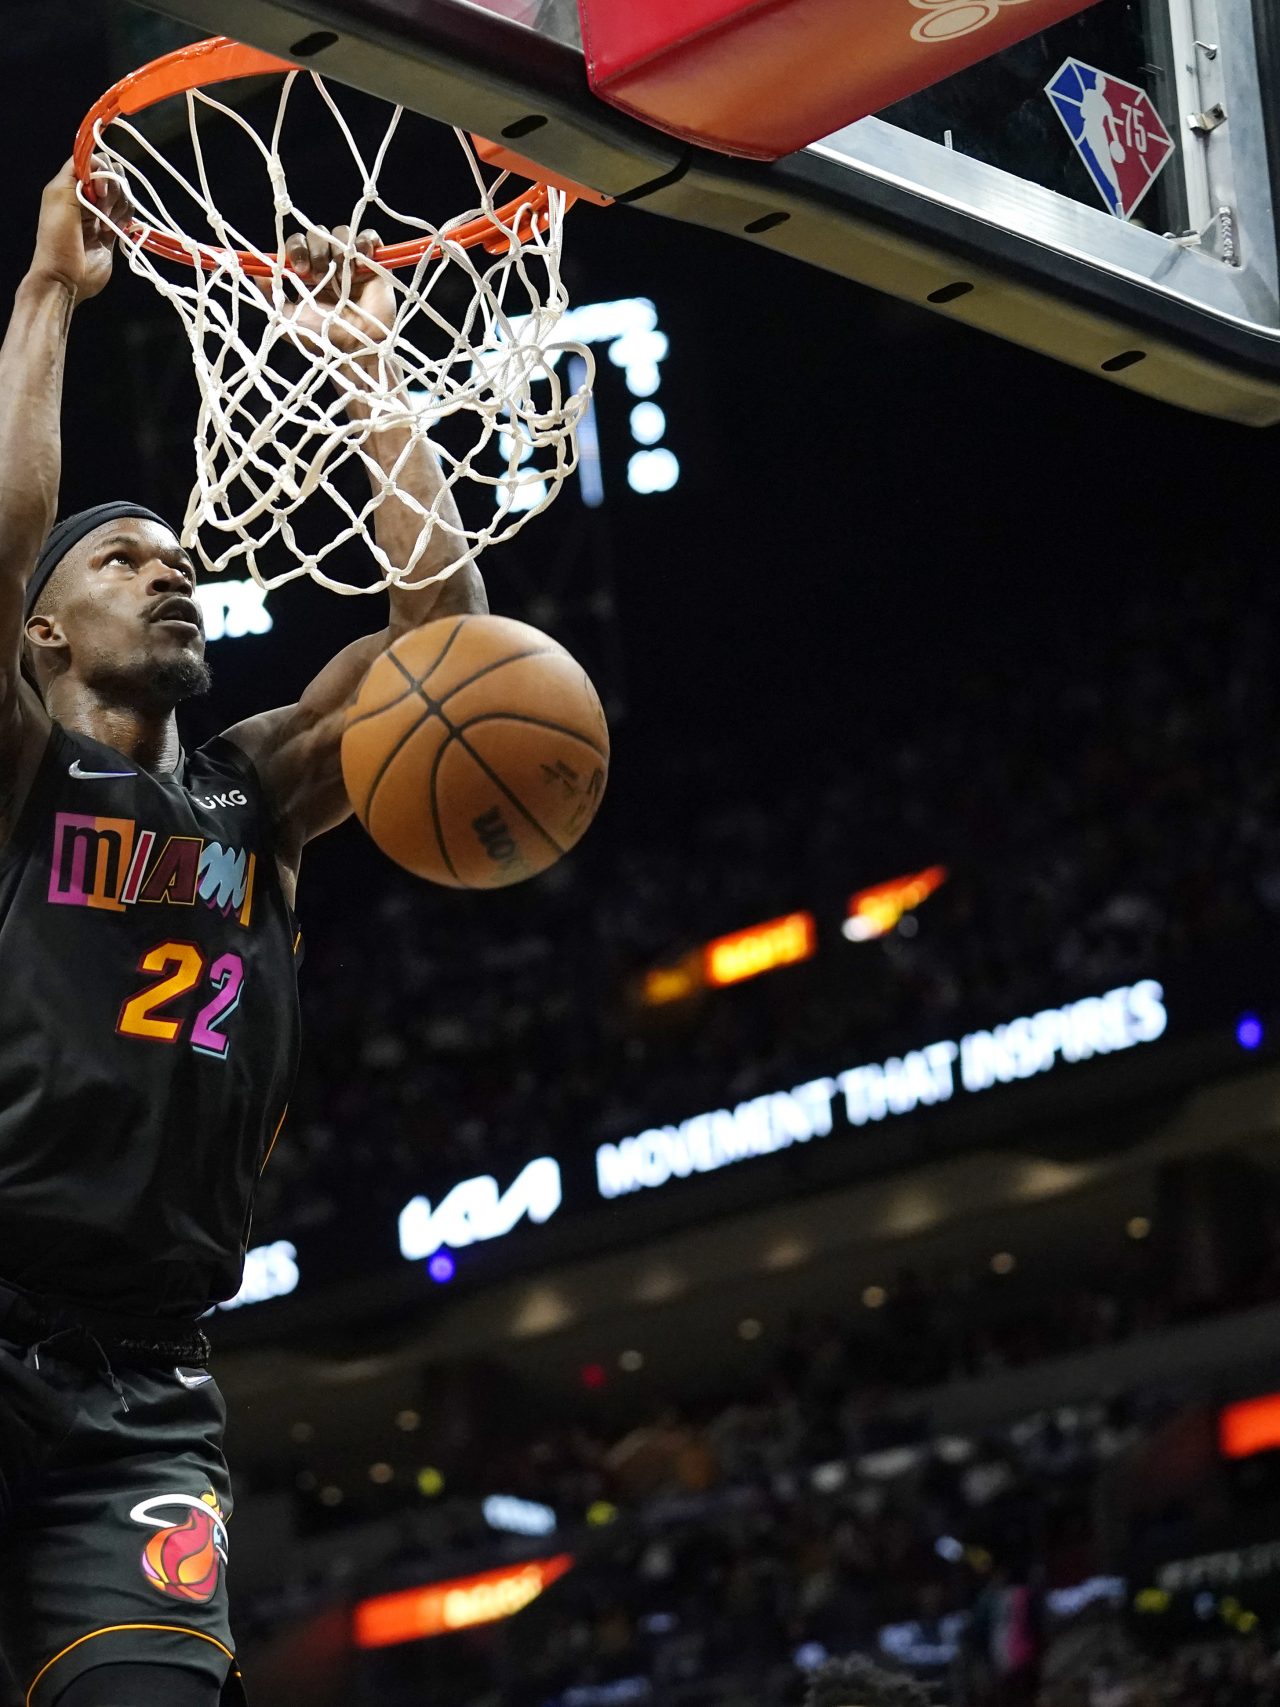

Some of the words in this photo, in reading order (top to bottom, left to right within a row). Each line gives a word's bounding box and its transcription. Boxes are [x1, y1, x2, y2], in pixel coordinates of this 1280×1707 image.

[1121, 102, 1147, 153] 75
[47, 812, 257, 928] MIAMI
[115, 938, 245, 1061] 22
[595, 1076, 838, 1199] MOVEMENT
[836, 1040, 959, 1127] THAT
[959, 979, 1168, 1093] INSPIRES
